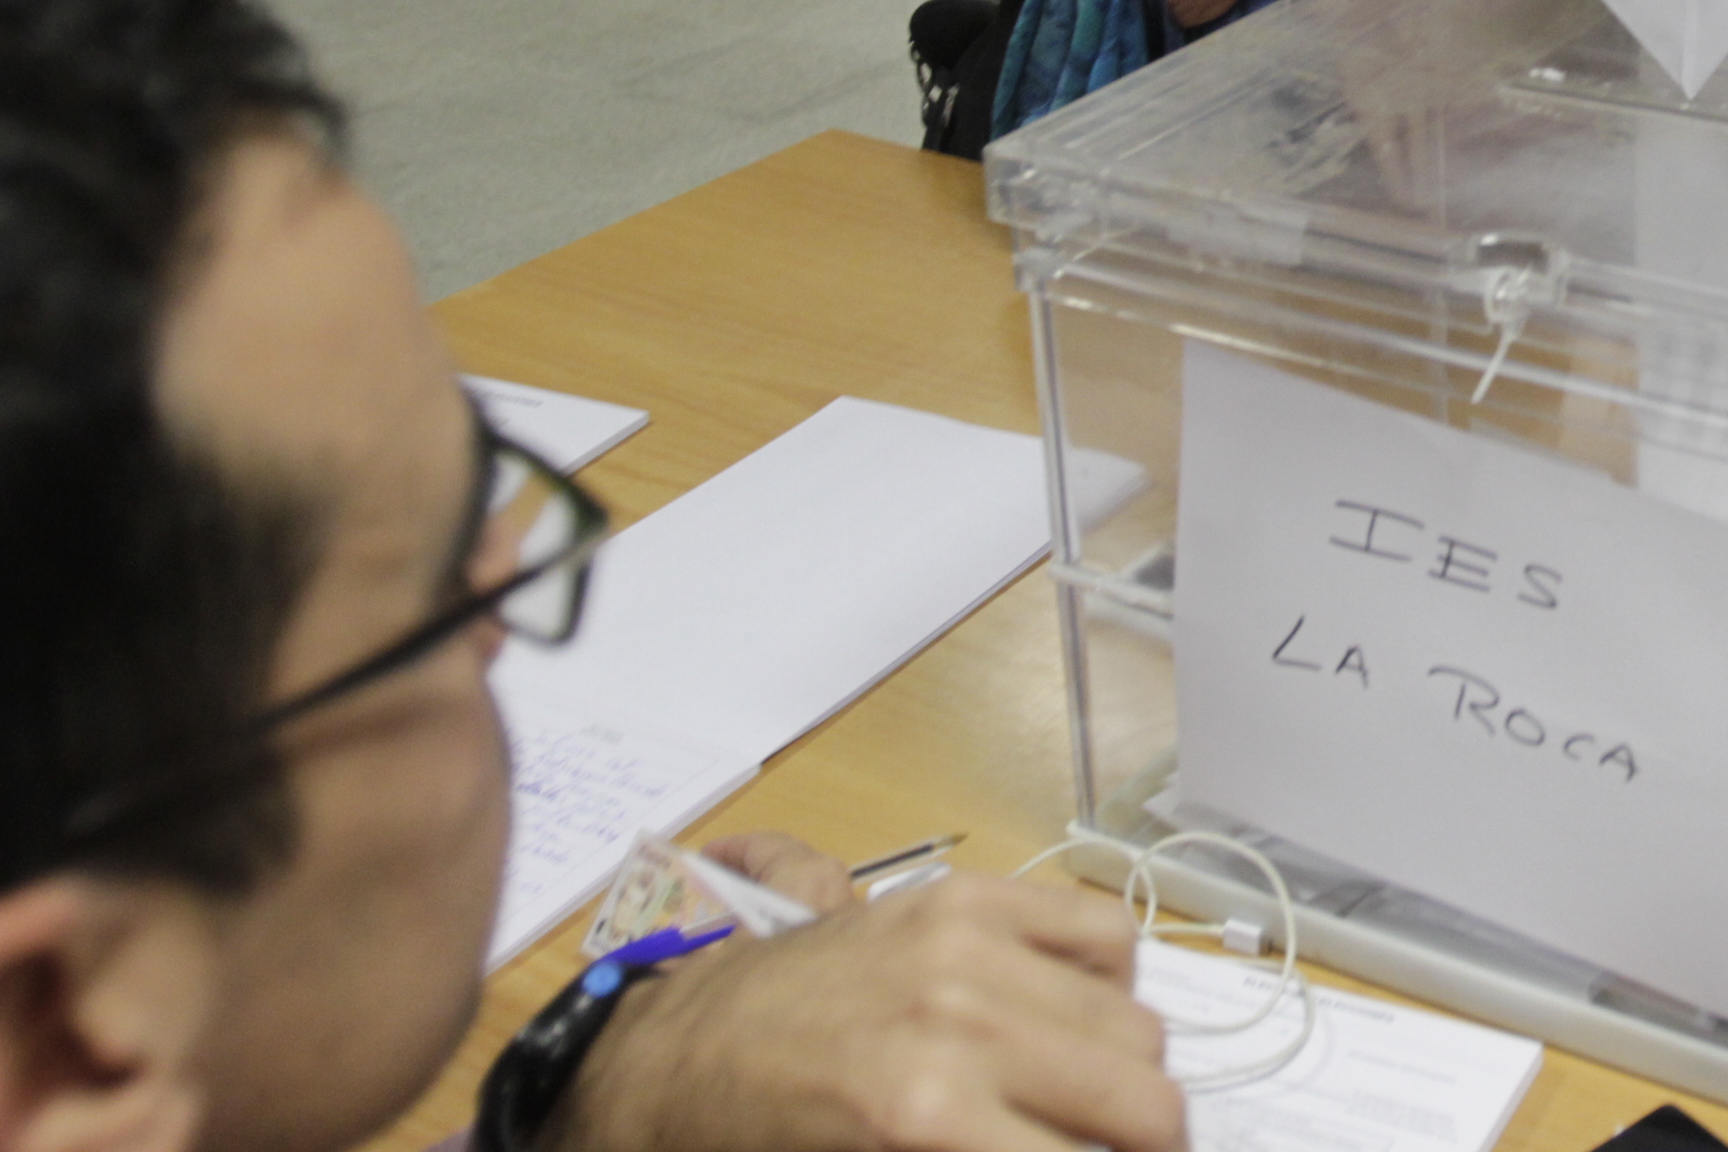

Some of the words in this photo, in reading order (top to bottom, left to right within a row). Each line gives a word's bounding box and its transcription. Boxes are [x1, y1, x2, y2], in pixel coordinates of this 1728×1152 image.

[1329, 499, 1563, 610] IES
[1271, 615, 1370, 688] LA
[1428, 665, 1640, 783] ROCA
